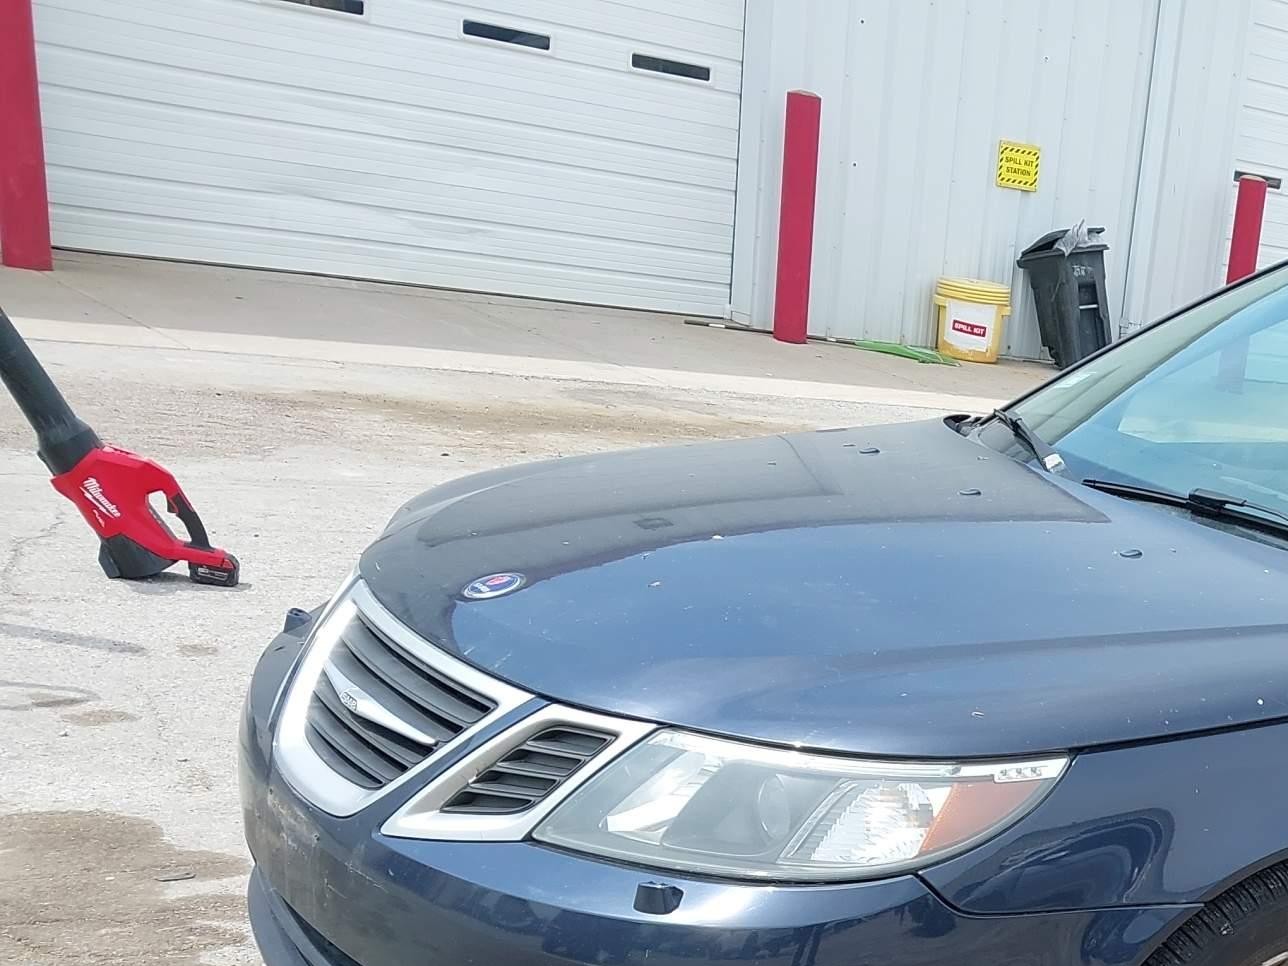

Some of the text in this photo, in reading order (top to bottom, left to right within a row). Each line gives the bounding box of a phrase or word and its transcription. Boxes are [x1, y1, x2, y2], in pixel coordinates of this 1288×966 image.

[1005, 156, 1034, 168] SPILL KIT
[1006, 166, 1031, 177] STATION
[954, 322, 985, 335] SPILL KIT
[83, 476, 121, 518] Milwaukee
